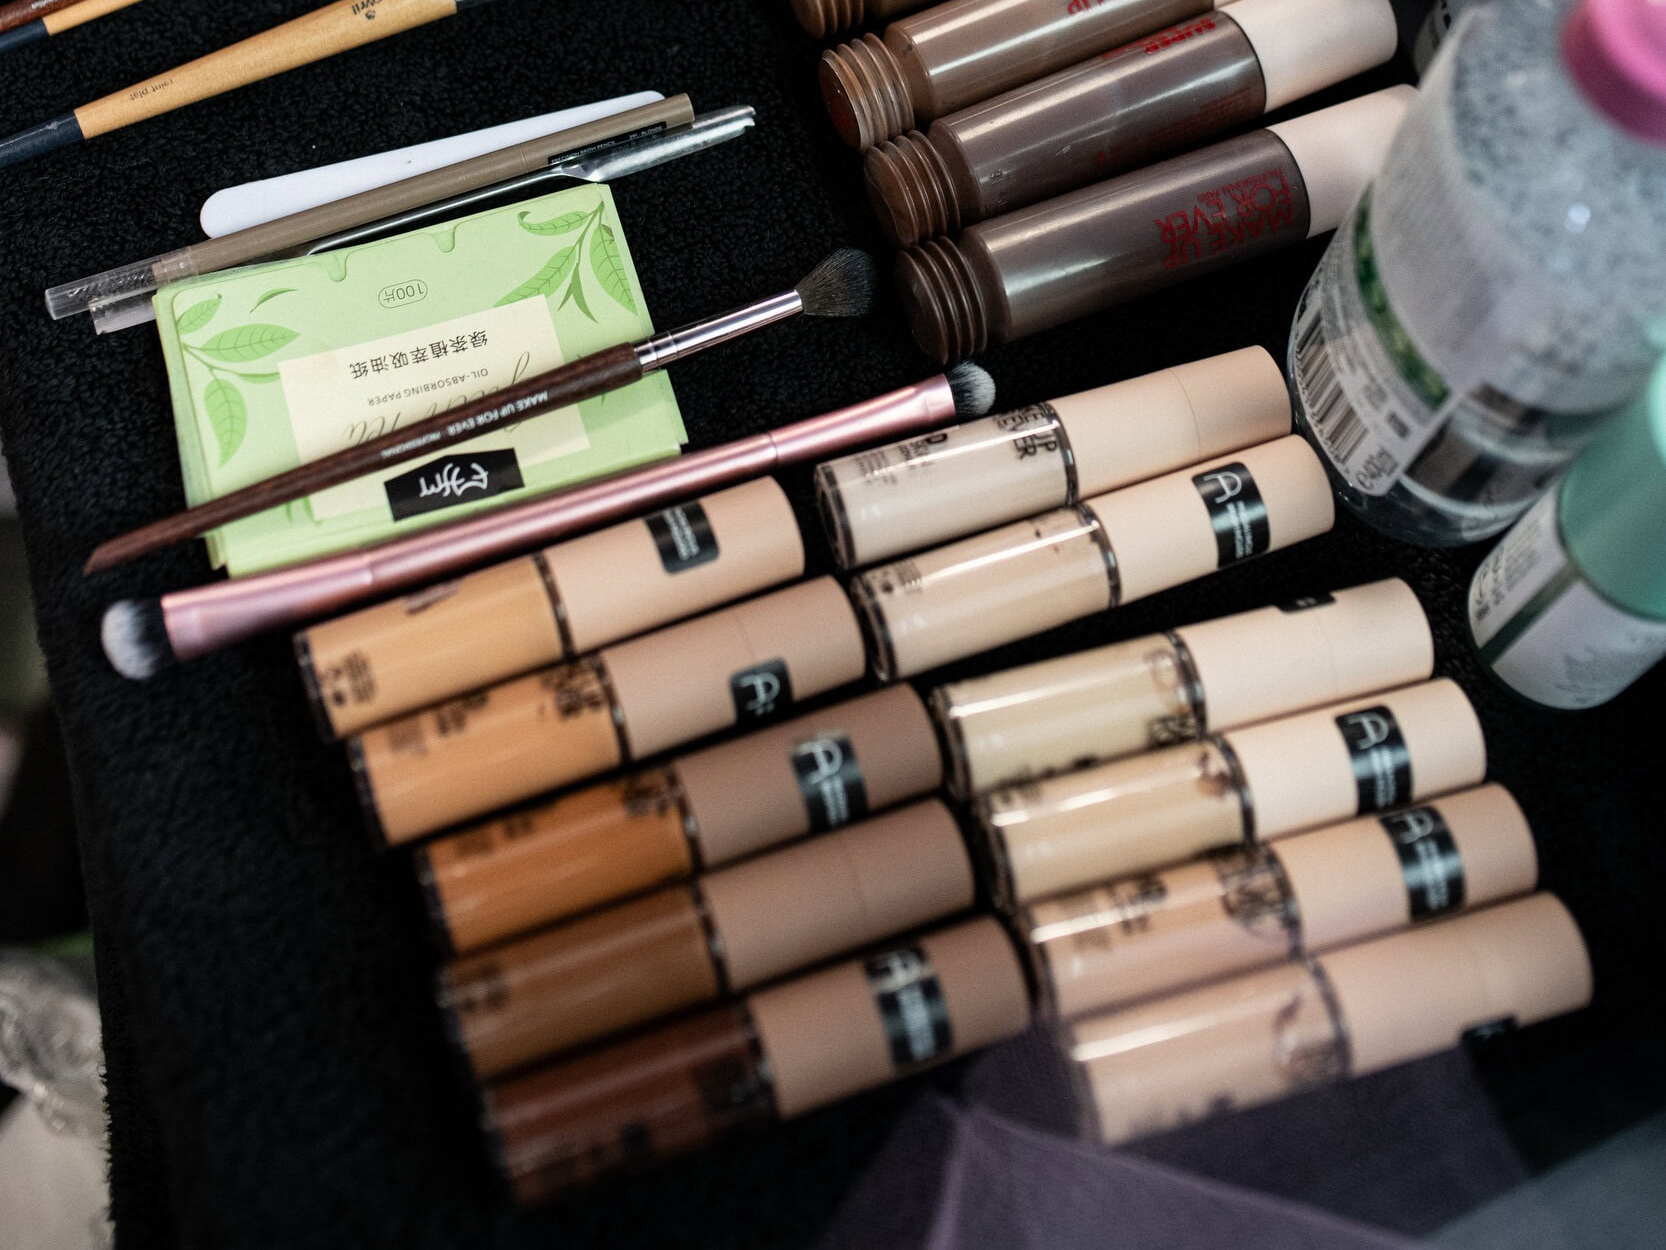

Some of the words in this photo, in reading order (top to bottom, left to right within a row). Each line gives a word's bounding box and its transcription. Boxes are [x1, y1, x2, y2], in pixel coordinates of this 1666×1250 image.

[1231, 173, 1293, 219] FOR
[1154, 196, 1230, 244] EVER
[1207, 200, 1295, 254] MAKE
[1164, 236, 1202, 270] UP
[383, 283, 425, 303] 100片
[348, 330, 489, 380] 绿茶植萃吸油纸
[403, 367, 489, 397] OIL-ABSORBING
[367, 390, 403, 407] PAPER
[499, 402, 516, 418] UP
[517, 390, 549, 413] MAKE
[446, 418, 476, 437] EVER
[476, 409, 500, 427] FOR
